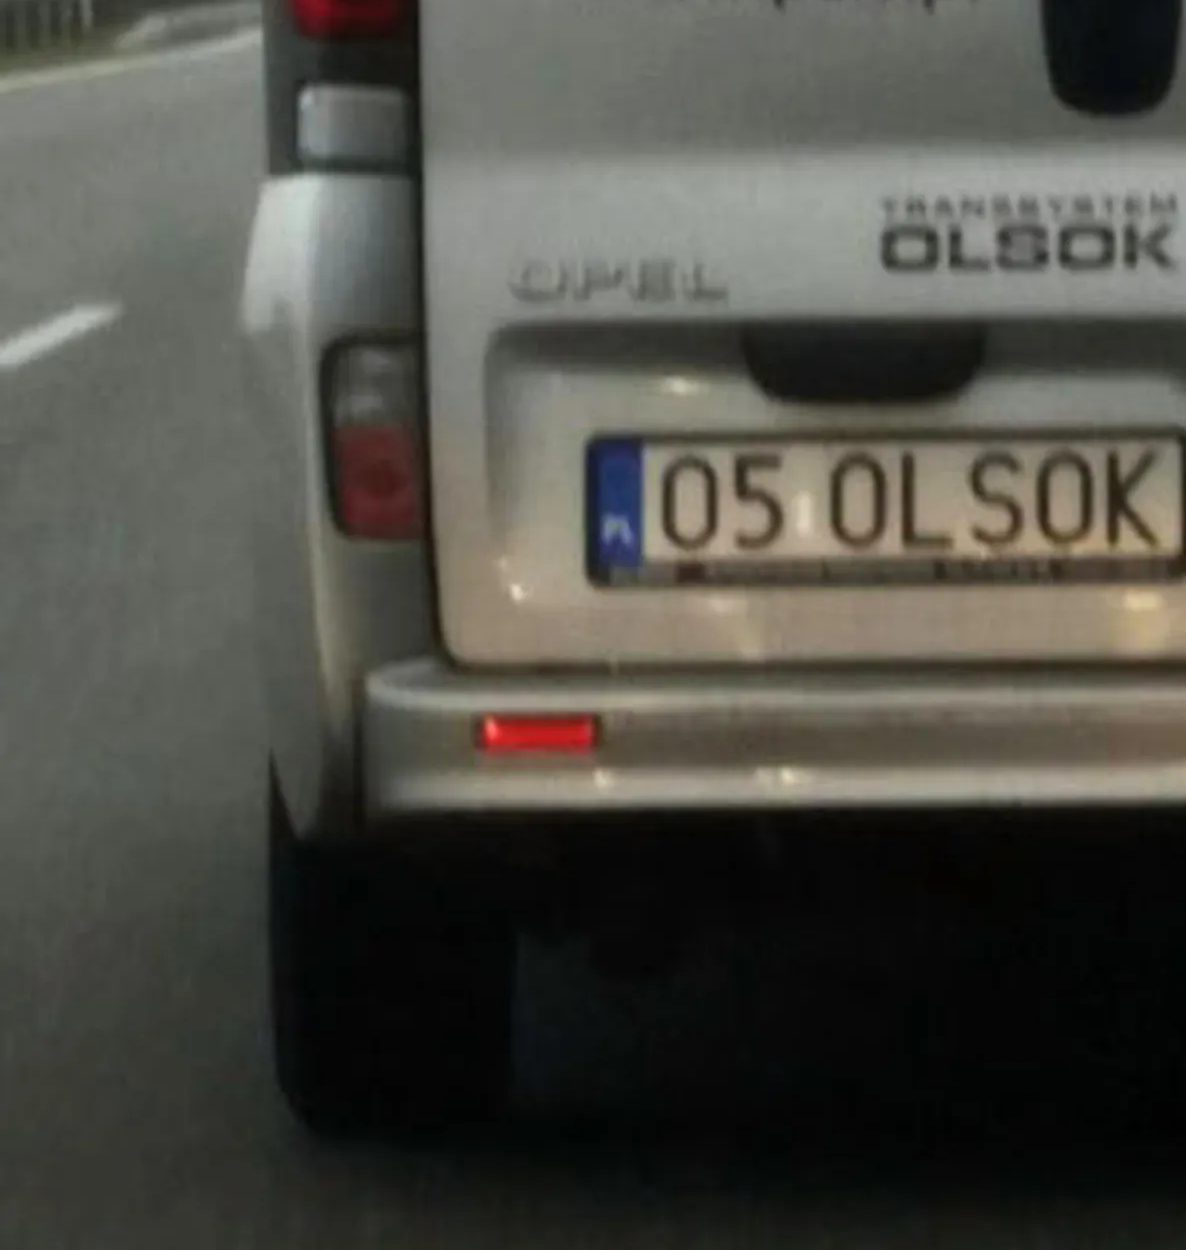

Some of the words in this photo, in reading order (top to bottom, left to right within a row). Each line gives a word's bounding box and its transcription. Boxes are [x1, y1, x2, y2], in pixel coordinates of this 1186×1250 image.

[880, 222, 1177, 273] OLSOK
[509, 258, 730, 303] OPEL
[829, 450, 1160, 551] OLSOK
